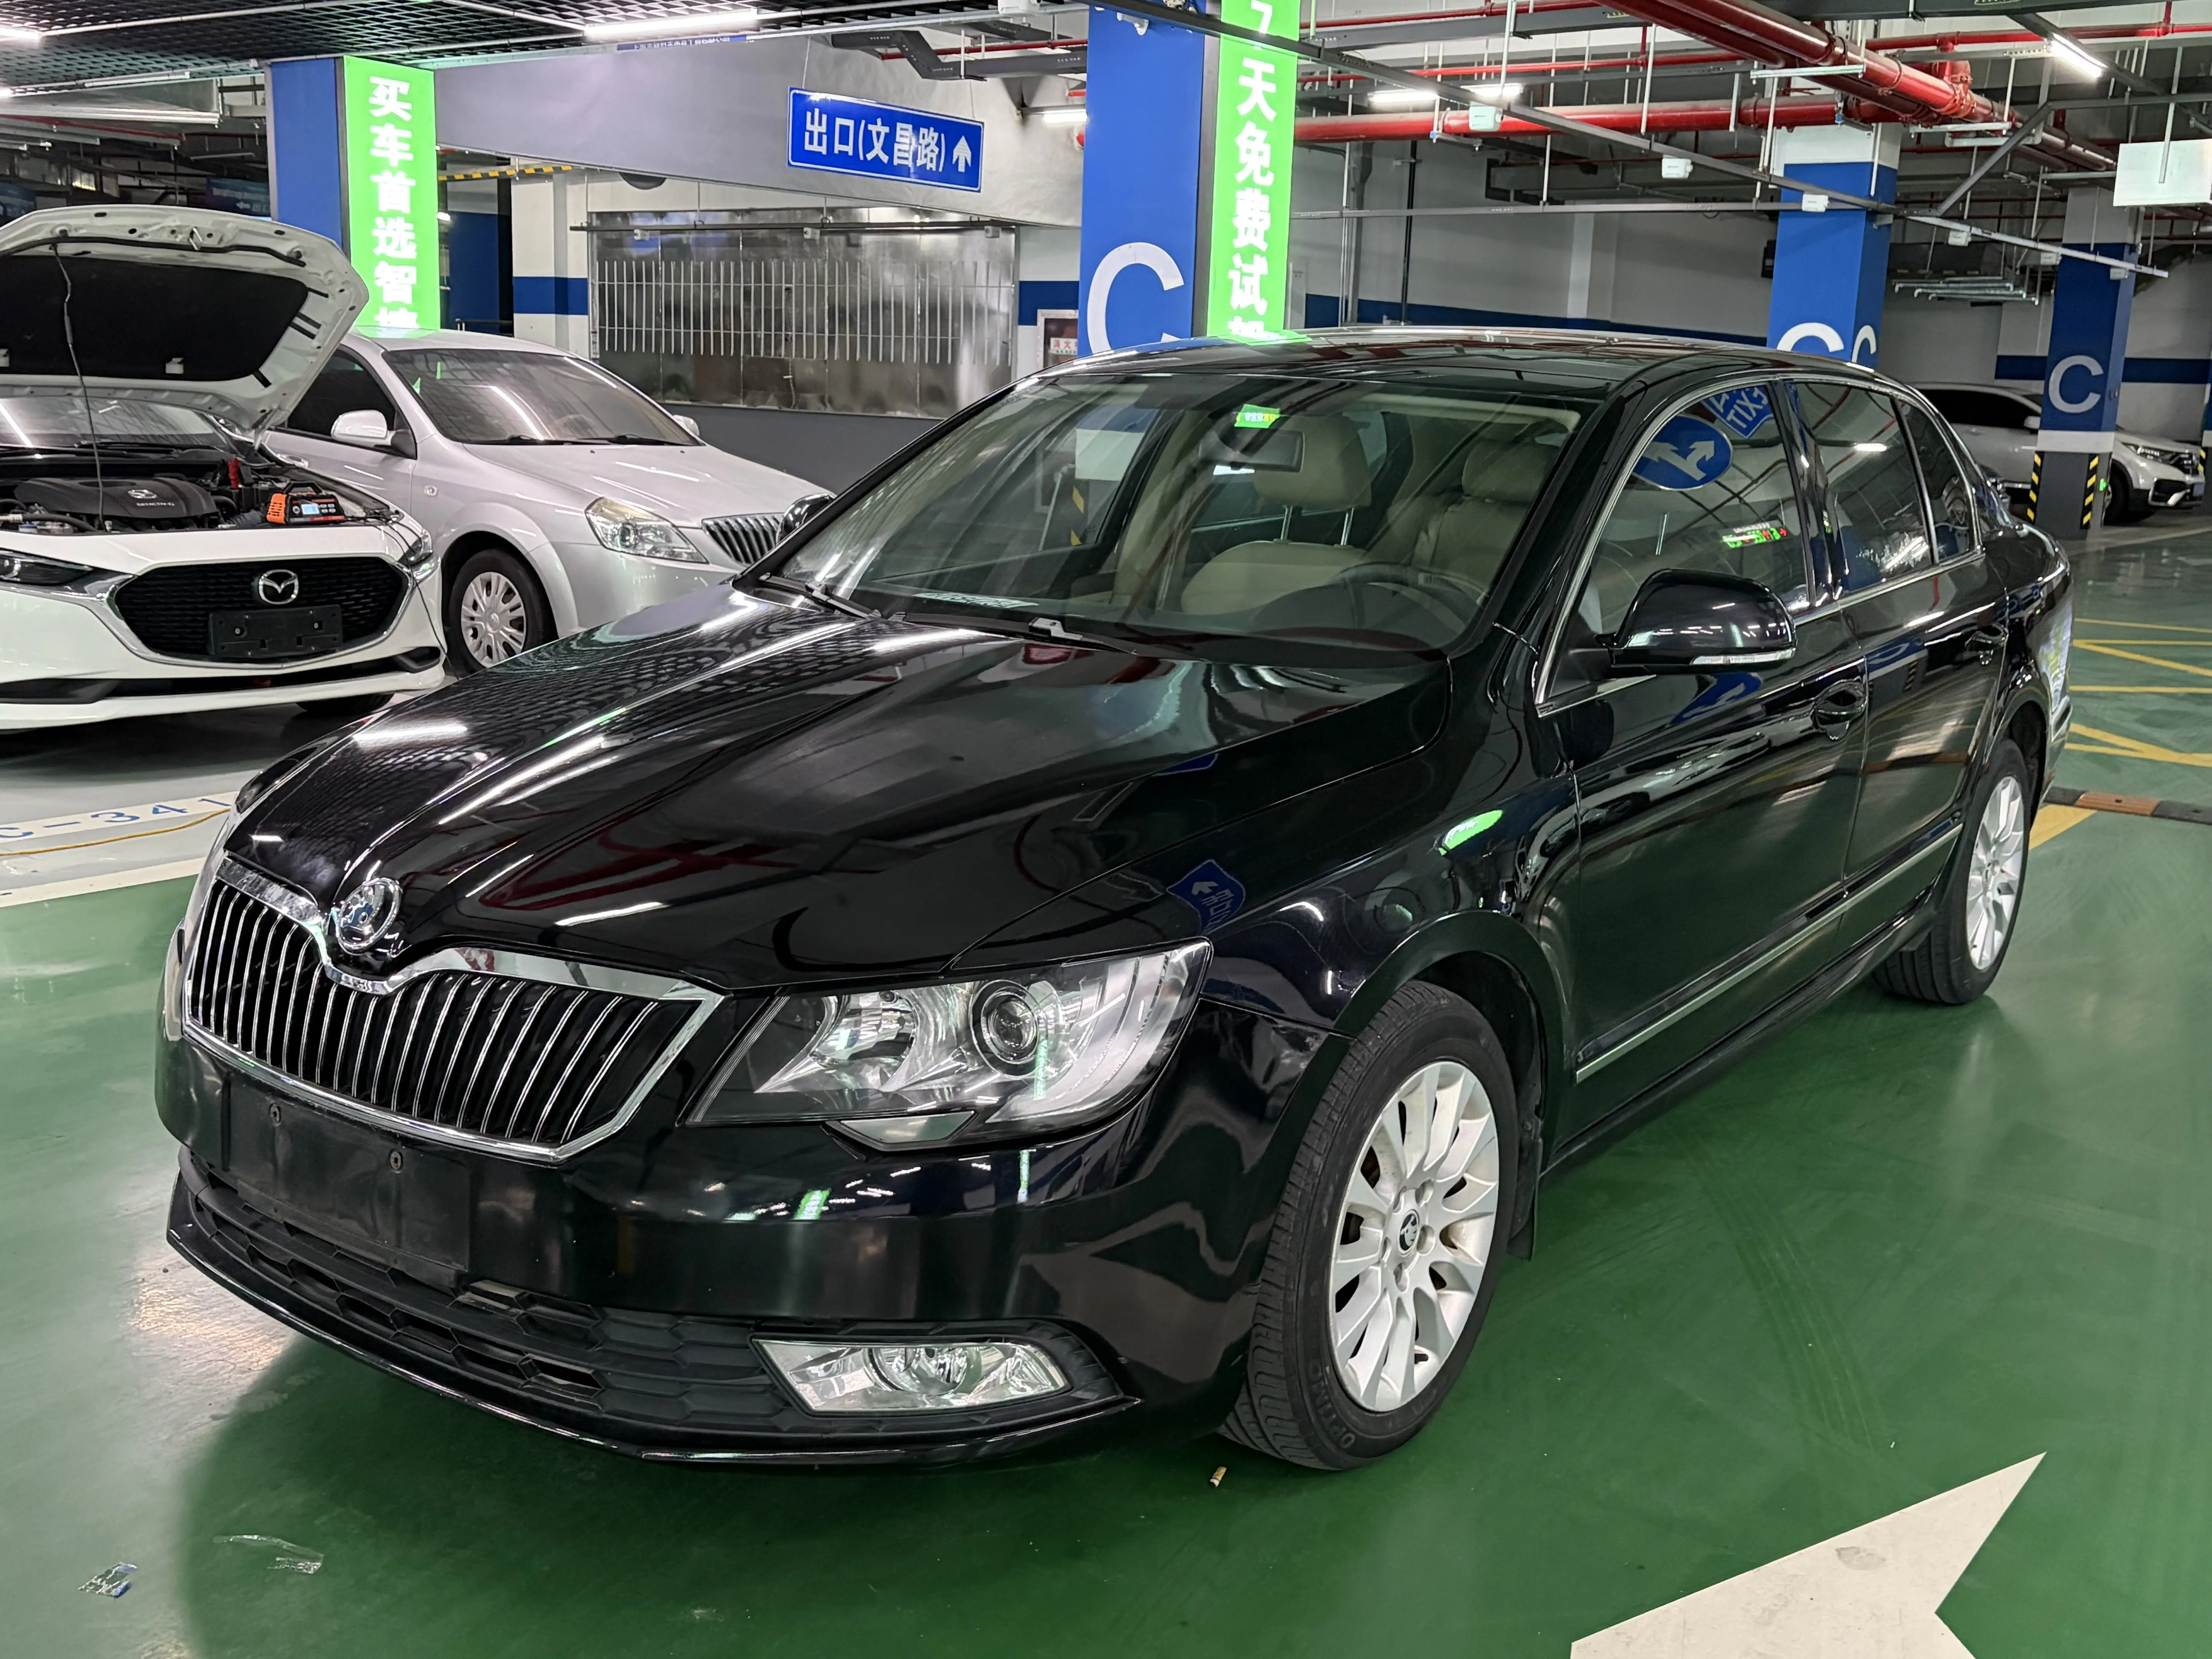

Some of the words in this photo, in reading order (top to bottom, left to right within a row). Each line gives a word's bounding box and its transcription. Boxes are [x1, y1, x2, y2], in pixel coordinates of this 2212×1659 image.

[804, 108, 945, 173] 出口(文昌路)
[1087, 242, 1184, 354] C
[2049, 355, 2104, 413] C
